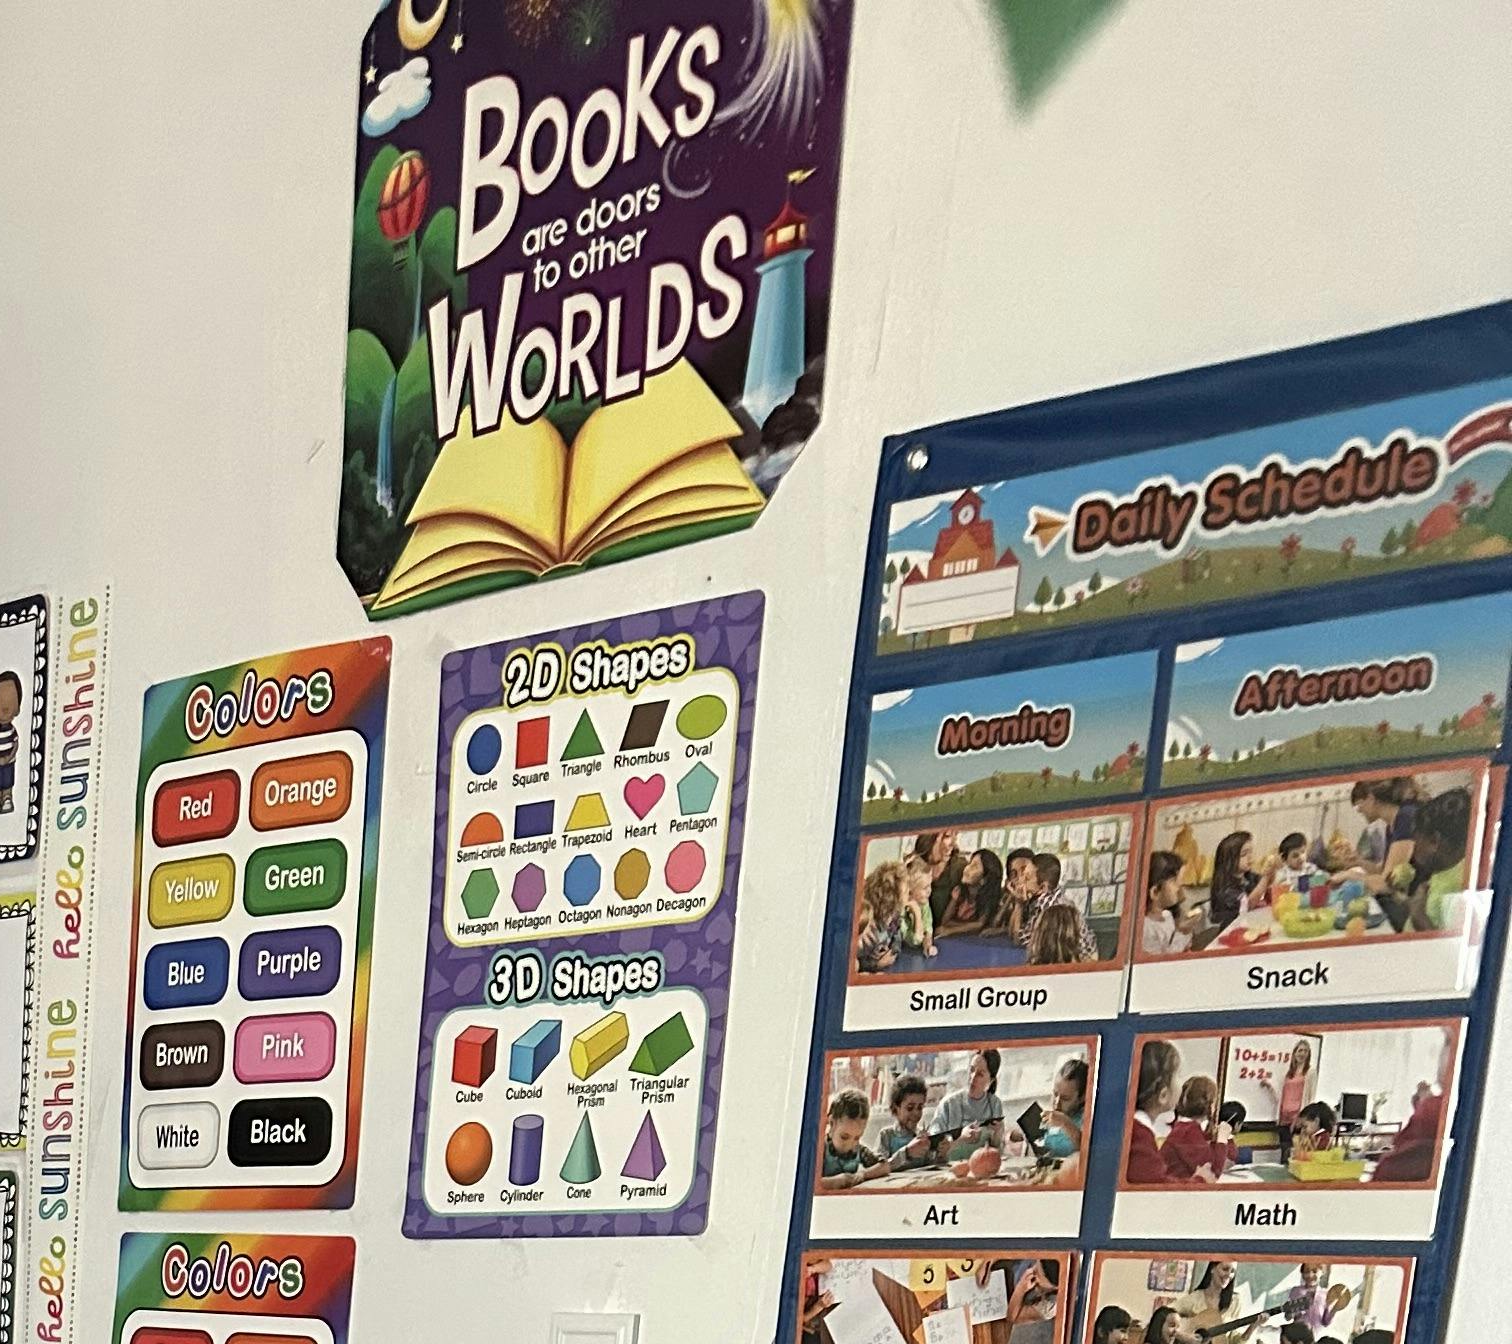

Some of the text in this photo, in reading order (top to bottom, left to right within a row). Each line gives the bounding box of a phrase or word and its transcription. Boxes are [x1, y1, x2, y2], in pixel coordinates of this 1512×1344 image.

[521, 180, 661, 259] are doors
[533, 225, 647, 295] to other
[1072, 436, 1440, 554] Daily Schedule
[506, 640, 691, 708] 2D Shapes
[1233, 656, 1434, 717] Afternoon
[185, 668, 333, 741] Colors
[938, 705, 1071, 756] Morning
[614, 750, 670, 769] Rhombus
[685, 741, 713, 758] Oval
[512, 770, 550, 788] Square
[561, 759, 602, 778] Triangle
[264, 774, 338, 808] Orange
[467, 778, 497, 794] Circle
[179, 796, 212, 823] Red
[624, 823, 657, 839] Heart
[669, 816, 718, 834] Pentagon
[165, 875, 220, 905] Yellow
[264, 865, 325, 892] Green
[656, 896, 706, 914] Decagon
[167, 960, 205, 988] Blue
[256, 944, 321, 980] Purple
[1245, 960, 1330, 991] Snack
[489, 954, 661, 1006] 3D Shapes
[909, 983, 1049, 1012] Small Group
[155, 1043, 209, 1069] Brown
[261, 1033, 304, 1061] Pink
[455, 1090, 484, 1103] Cube
[506, 1086, 543, 1101] Cuboid
[38, 998, 78, 1222] sunshine
[155, 1124, 199, 1151] White
[250, 1118, 306, 1145] Black
[446, 1190, 484, 1205] Sphere
[500, 1189, 544, 1203] Cylinder
[567, 1187, 591, 1199] Cone
[620, 1184, 666, 1198] Pyramid
[923, 1204, 959, 1226] Art
[1234, 1202, 1298, 1227] Math
[163, 1242, 303, 1299] Colors
[37, 1234, 67, 1343] hello
